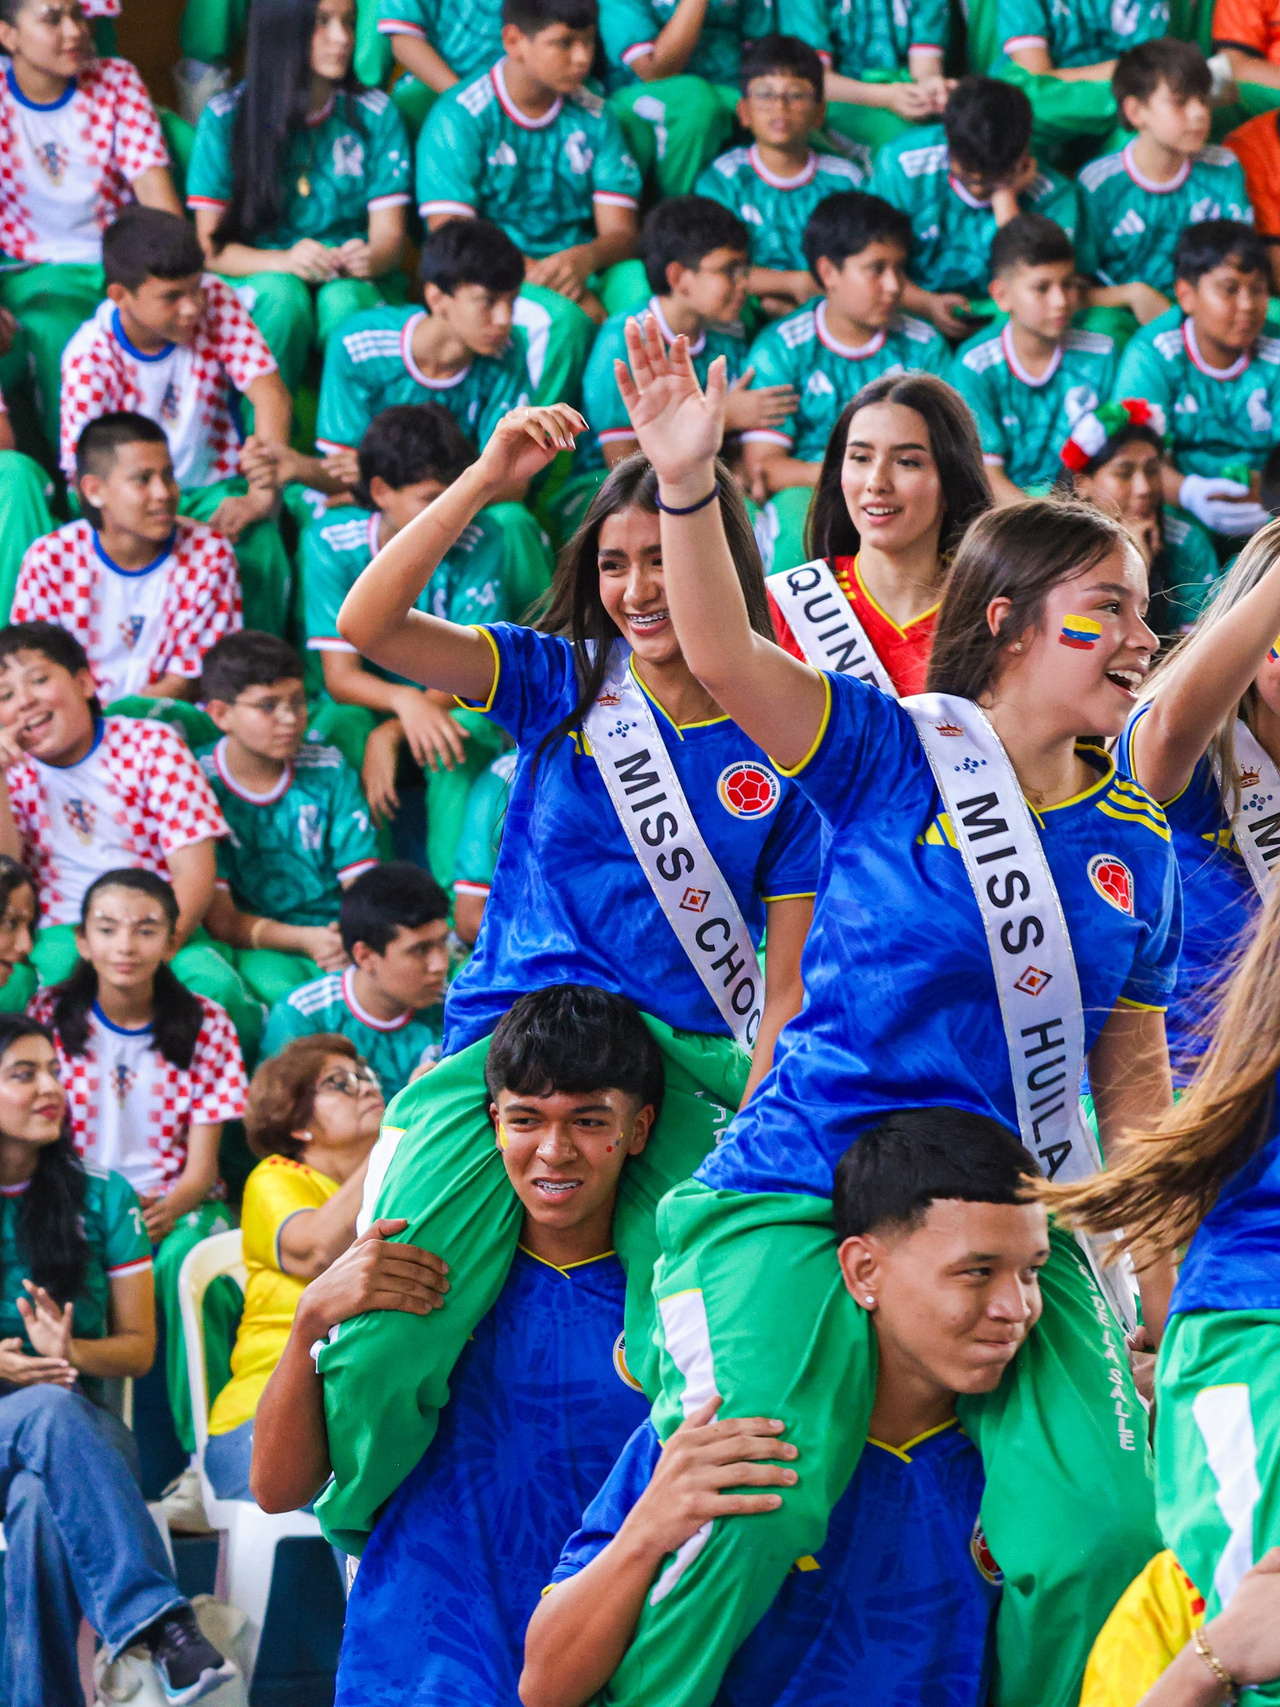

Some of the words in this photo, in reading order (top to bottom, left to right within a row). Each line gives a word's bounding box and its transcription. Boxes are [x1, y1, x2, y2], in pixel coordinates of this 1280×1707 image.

[614, 749, 695, 881] MISS
[956, 792, 1044, 954] MISS
[1021, 1018, 1073, 1182] HUILA
[1091, 1295, 1112, 1328] DE
[1102, 1331, 1120, 1364] LA
[1107, 1368, 1137, 1451] SALLE
